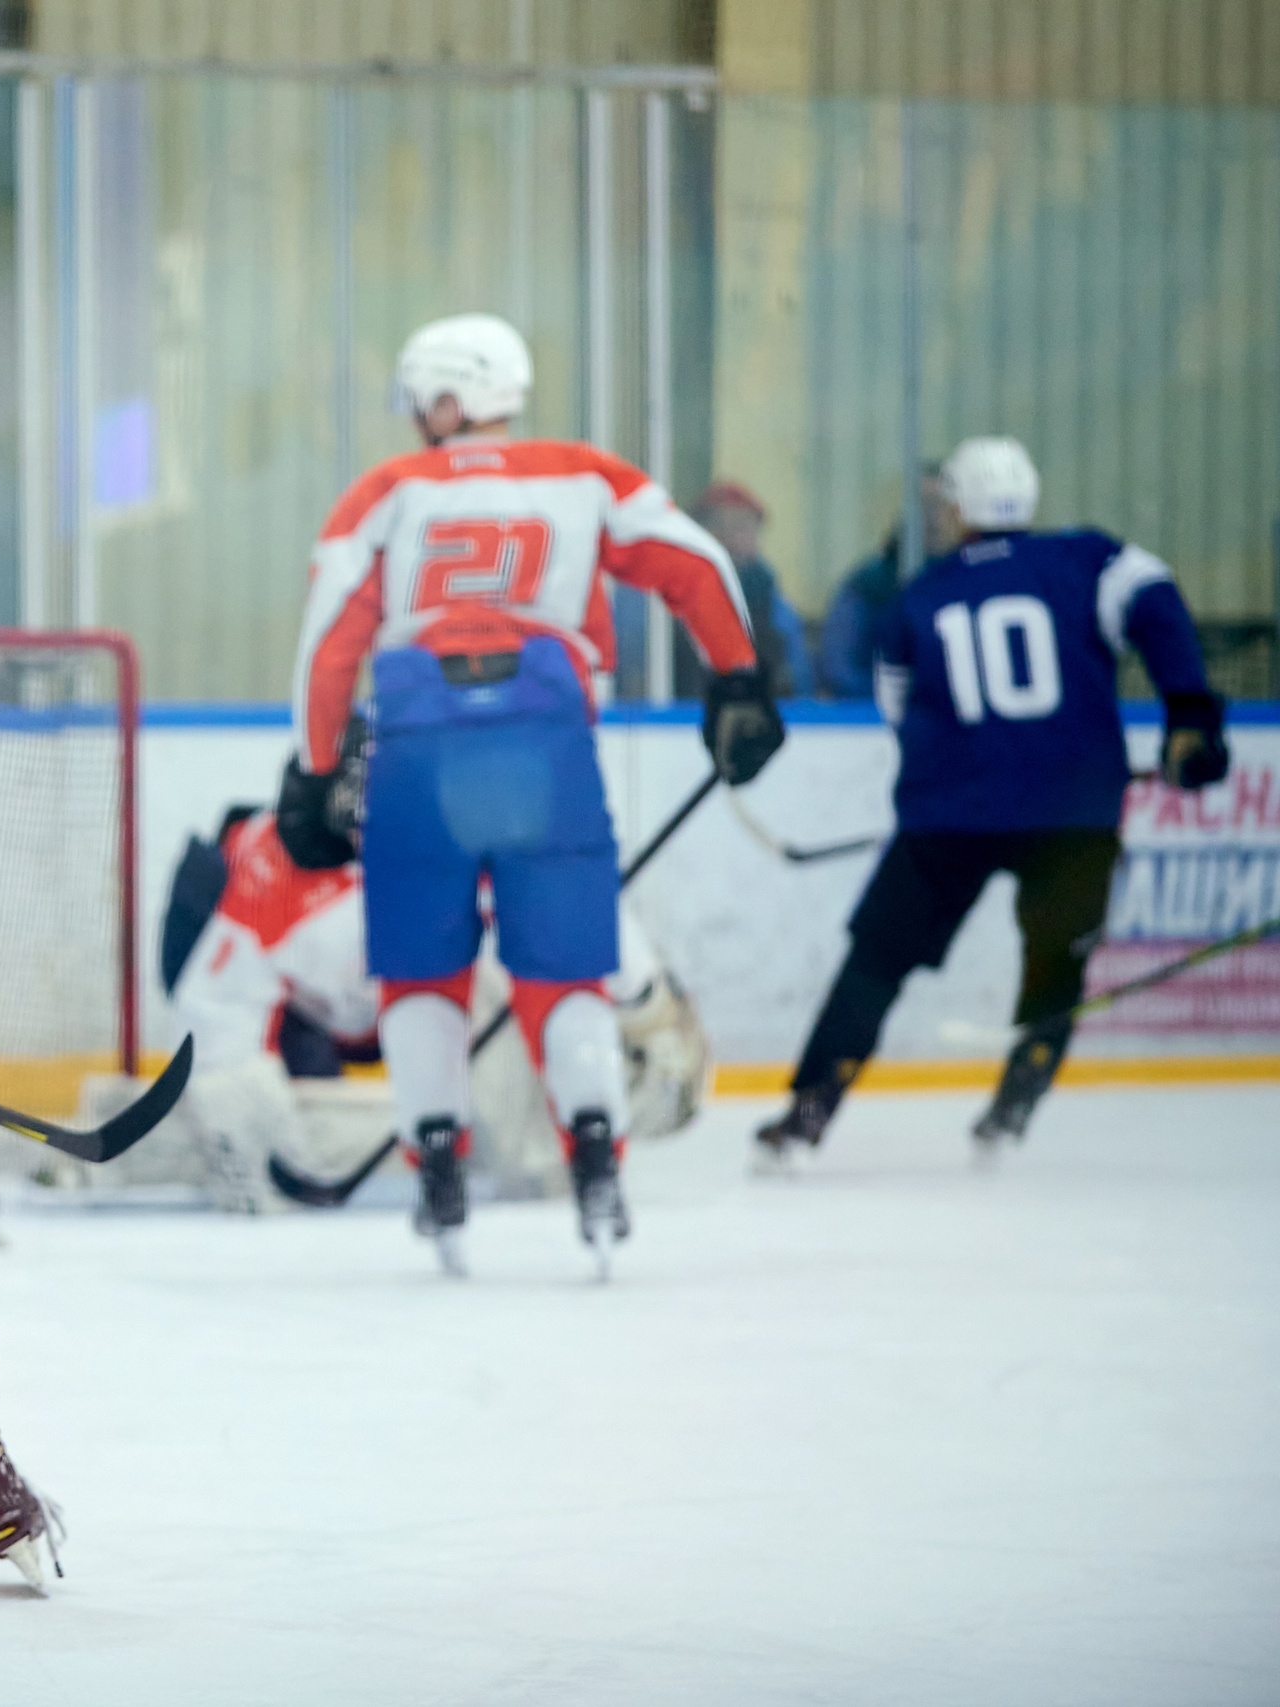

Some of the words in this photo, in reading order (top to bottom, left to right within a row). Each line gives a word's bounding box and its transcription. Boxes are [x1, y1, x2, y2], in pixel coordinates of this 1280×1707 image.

[409, 517, 554, 613] 21
[934, 595, 1062, 724] 10
[1122, 770, 1280, 832] РАСН
